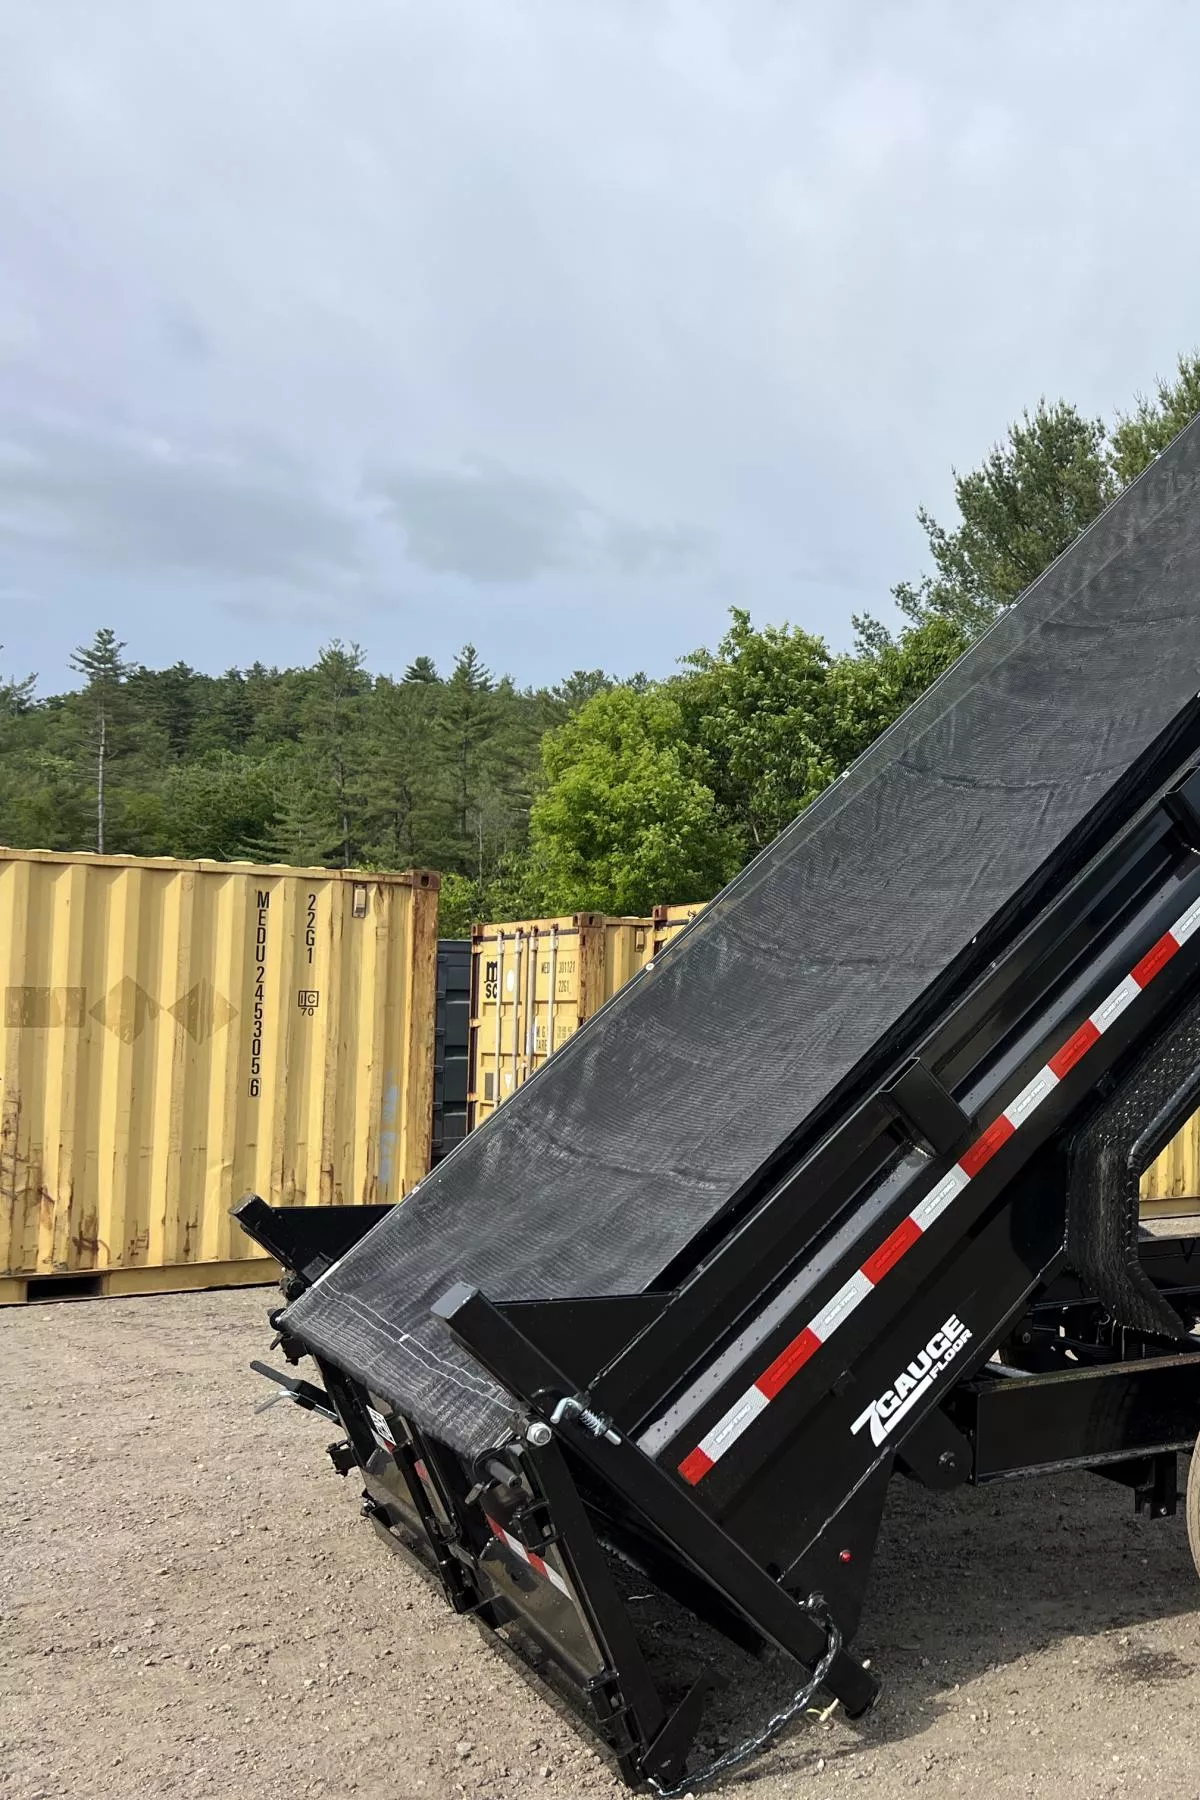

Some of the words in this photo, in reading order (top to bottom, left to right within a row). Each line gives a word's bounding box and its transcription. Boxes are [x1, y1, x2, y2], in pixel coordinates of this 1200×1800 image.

[256, 891, 270, 963] MEDU
[305, 894, 316, 964] 22G1
[251, 966, 265, 1075] 245305
[301, 1008, 314, 1017] 70
[250, 1079, 260, 1098] 6
[929, 1328, 973, 1379] FLOOR
